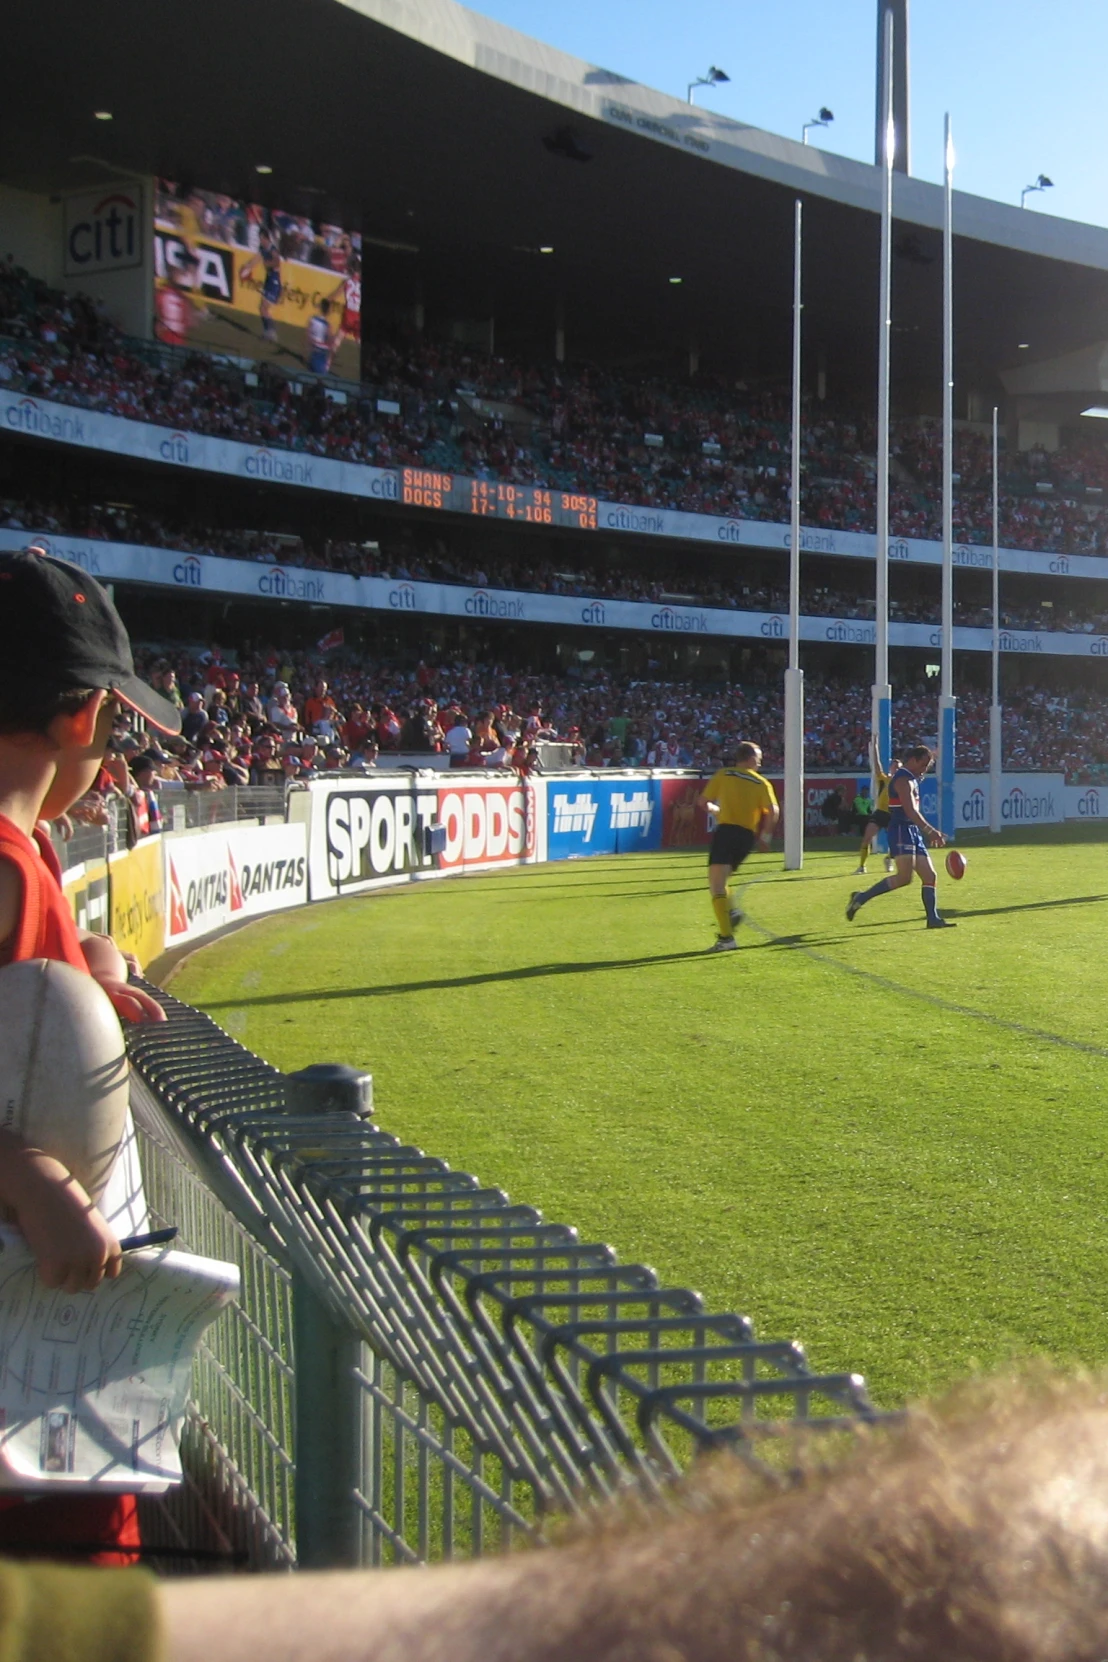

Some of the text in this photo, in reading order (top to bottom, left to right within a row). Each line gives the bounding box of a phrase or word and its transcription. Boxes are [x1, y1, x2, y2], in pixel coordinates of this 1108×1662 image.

[69, 195, 136, 264] citi
[6, 398, 85, 441] citibank
[159, 433, 189, 463] citi
[244, 449, 313, 483] citibank
[371, 471, 397, 498] citi
[403, 468, 452, 492] SWANS
[561, 493, 598, 513] 3052
[403, 486, 442, 508] DOGS
[578, 513, 597, 529] 04
[607, 506, 664, 532] citibank
[717, 520, 740, 542] citi
[888, 539, 909, 559] citi
[173, 556, 200, 585] citi
[1049, 555, 1069, 575] citi
[258, 567, 325, 600] citibank
[389, 583, 415, 608] citi
[465, 590, 525, 618] citibank
[581, 601, 605, 624] citi
[651, 607, 708, 631] citibank
[760, 615, 783, 637] citi
[962, 788, 985, 821] citi
[1002, 787, 1055, 819] citibank
[1077, 788, 1099, 815] citi
[241, 856, 305, 901] QANTAS
